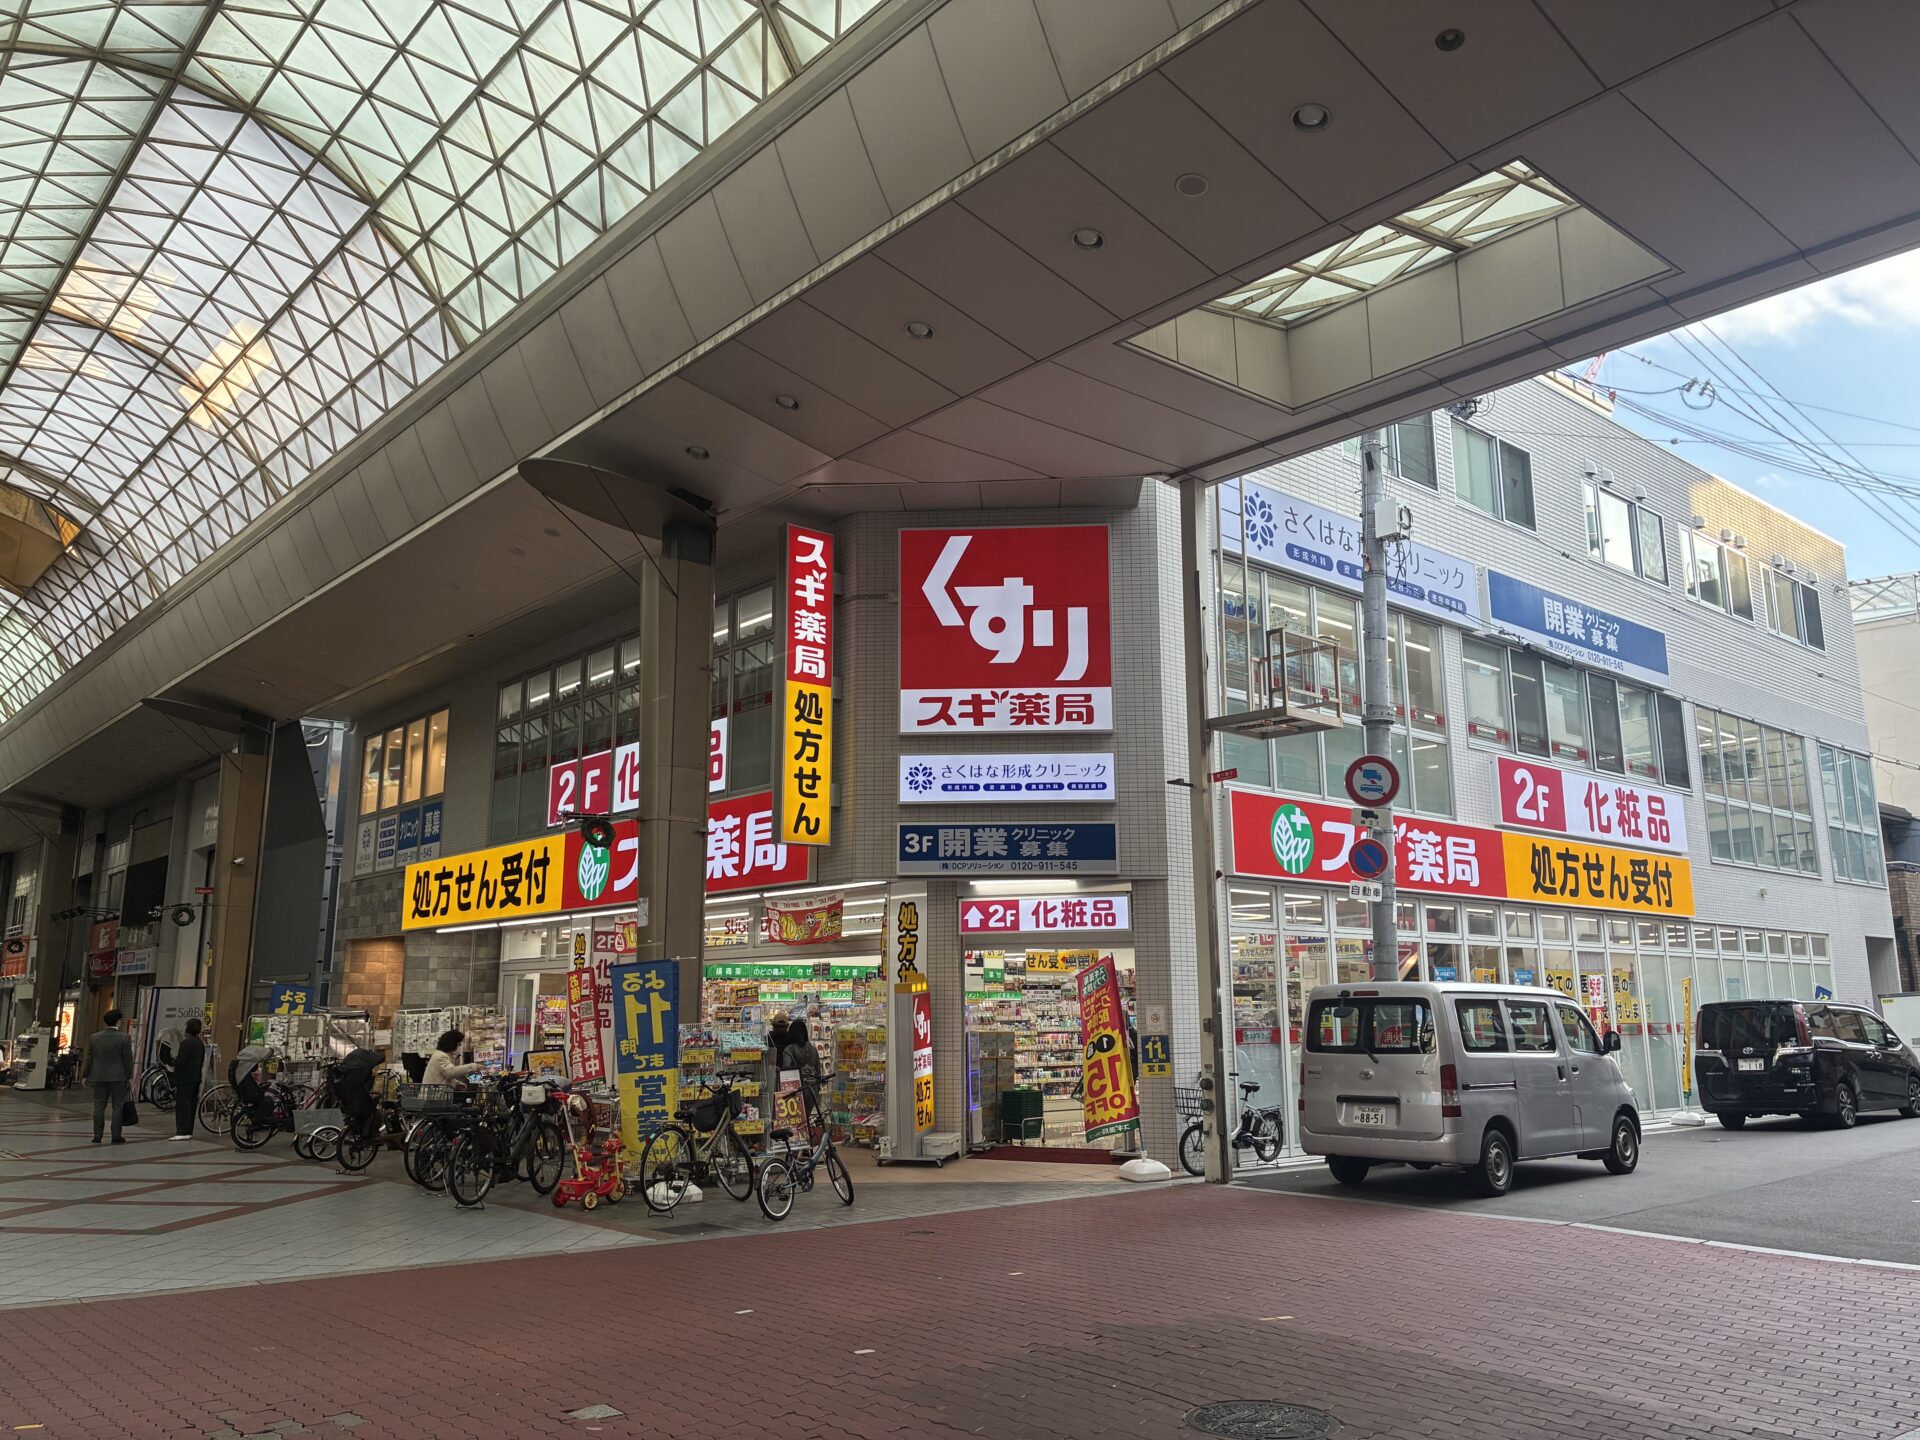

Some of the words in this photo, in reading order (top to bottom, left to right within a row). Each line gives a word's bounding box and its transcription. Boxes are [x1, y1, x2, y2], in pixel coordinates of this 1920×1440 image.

[794, 534, 827, 679] スギ薬局
[921, 535, 1089, 681] くすり
[1543, 596, 1586, 640] 開業
[1585, 612, 1620, 636] クリニック
[1591, 628, 1618, 653] 募集
[916, 690, 1095, 727] スギ薬局
[793, 689, 824, 836] 処方せん
[941, 763, 1107, 780] さくはな形成クリニック
[557, 768, 601, 820] 2F
[1513, 767, 1550, 822] 2F
[1584, 780, 1671, 844] 化粧品
[904, 833, 933, 853] 3F
[938, 827, 1008, 858] 開業
[1011, 828, 1076, 841] クリニック
[1019, 840, 1069, 857] 募集
[613, 810, 788, 892] ス薬局
[1010, 861, 1078, 871] 0120-911-545
[1530, 842, 1673, 908] 処方せん受付
[411, 845, 550, 920] 処方せん受付
[1351, 884, 1381, 897] 自動車
[988, 904, 1017, 928] 2F
[1031, 899, 1117, 928] 化粧品
[280, 989, 307, 1004] よる
[914, 998, 931, 1044] くすり
[914, 1053, 931, 1072] スギ薬局
[916, 1079, 931, 1103] 処方
[917, 1104, 932, 1126] せん
[1360, 1113, 1384, 1124] 88-51
